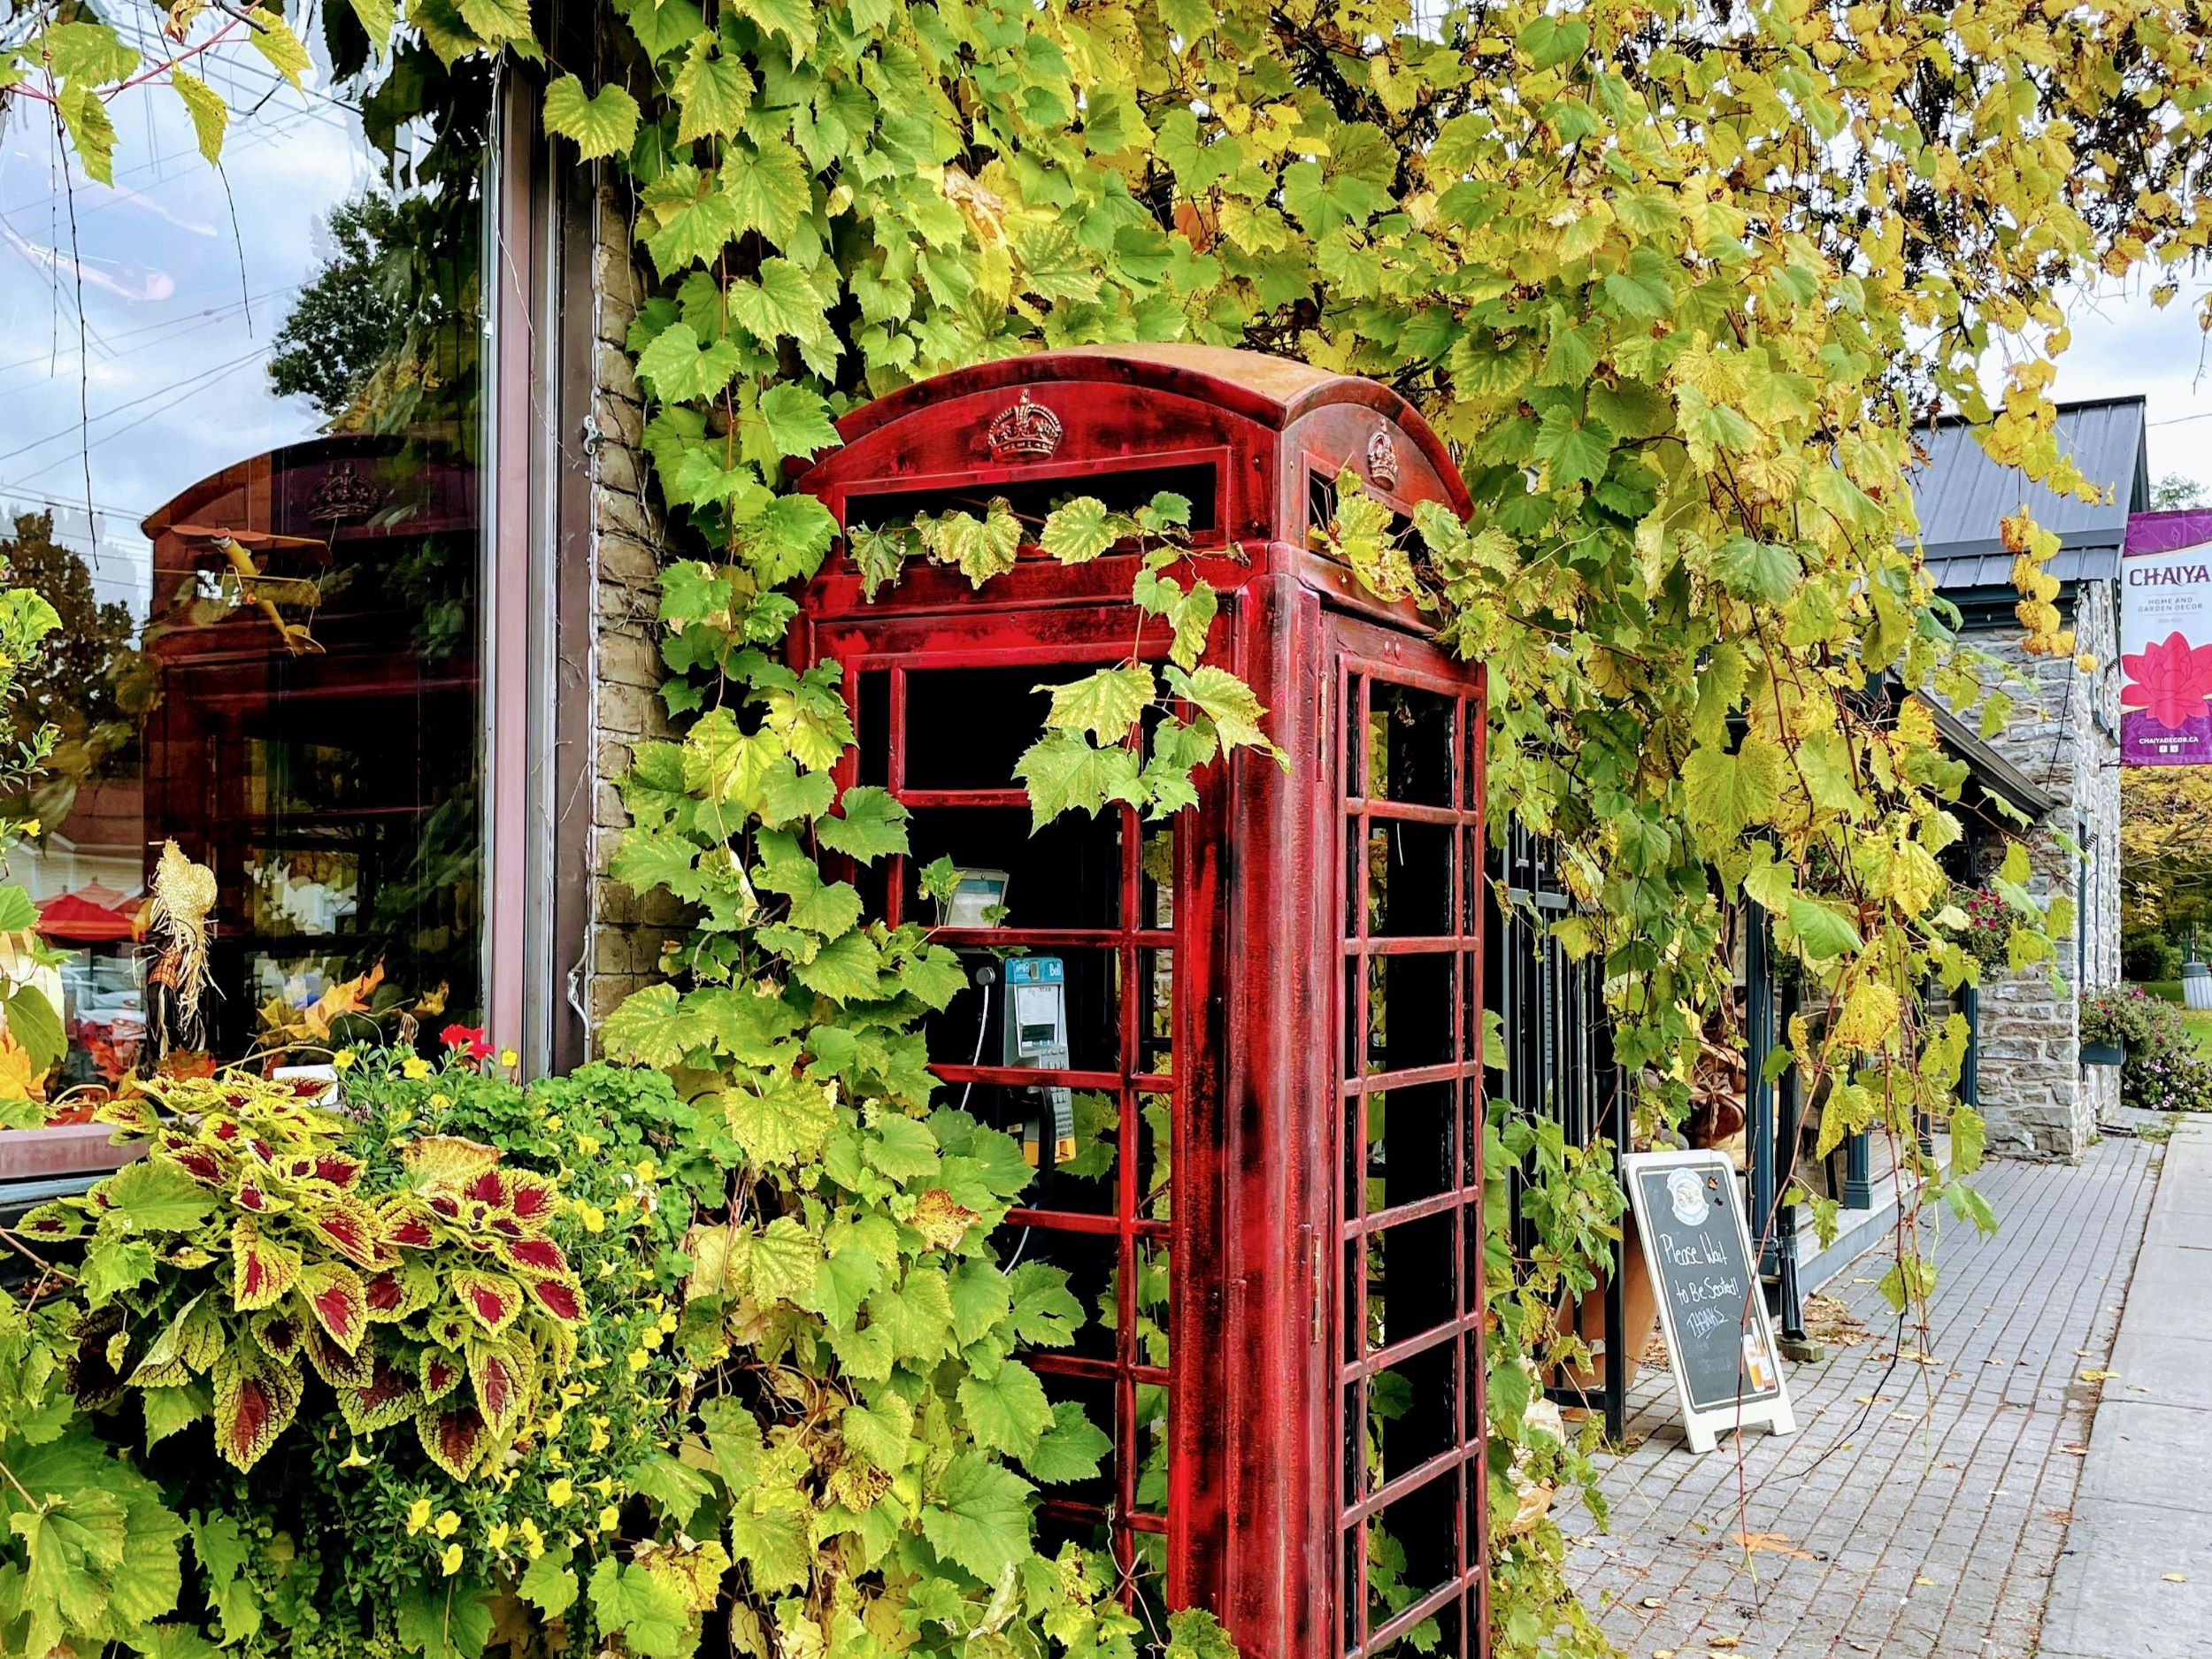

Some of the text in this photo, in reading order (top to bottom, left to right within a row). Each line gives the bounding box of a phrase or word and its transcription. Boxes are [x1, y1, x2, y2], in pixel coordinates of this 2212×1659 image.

[2129, 565, 2211, 587] CHAIYA
[1048, 962, 1062, 977] Bell
[1659, 1231, 1728, 1266] Please Wait
[1675, 1279, 1689, 1305] to
[1688, 1281, 1708, 1302] Be
[1686, 1305, 1729, 1338] THANKS
